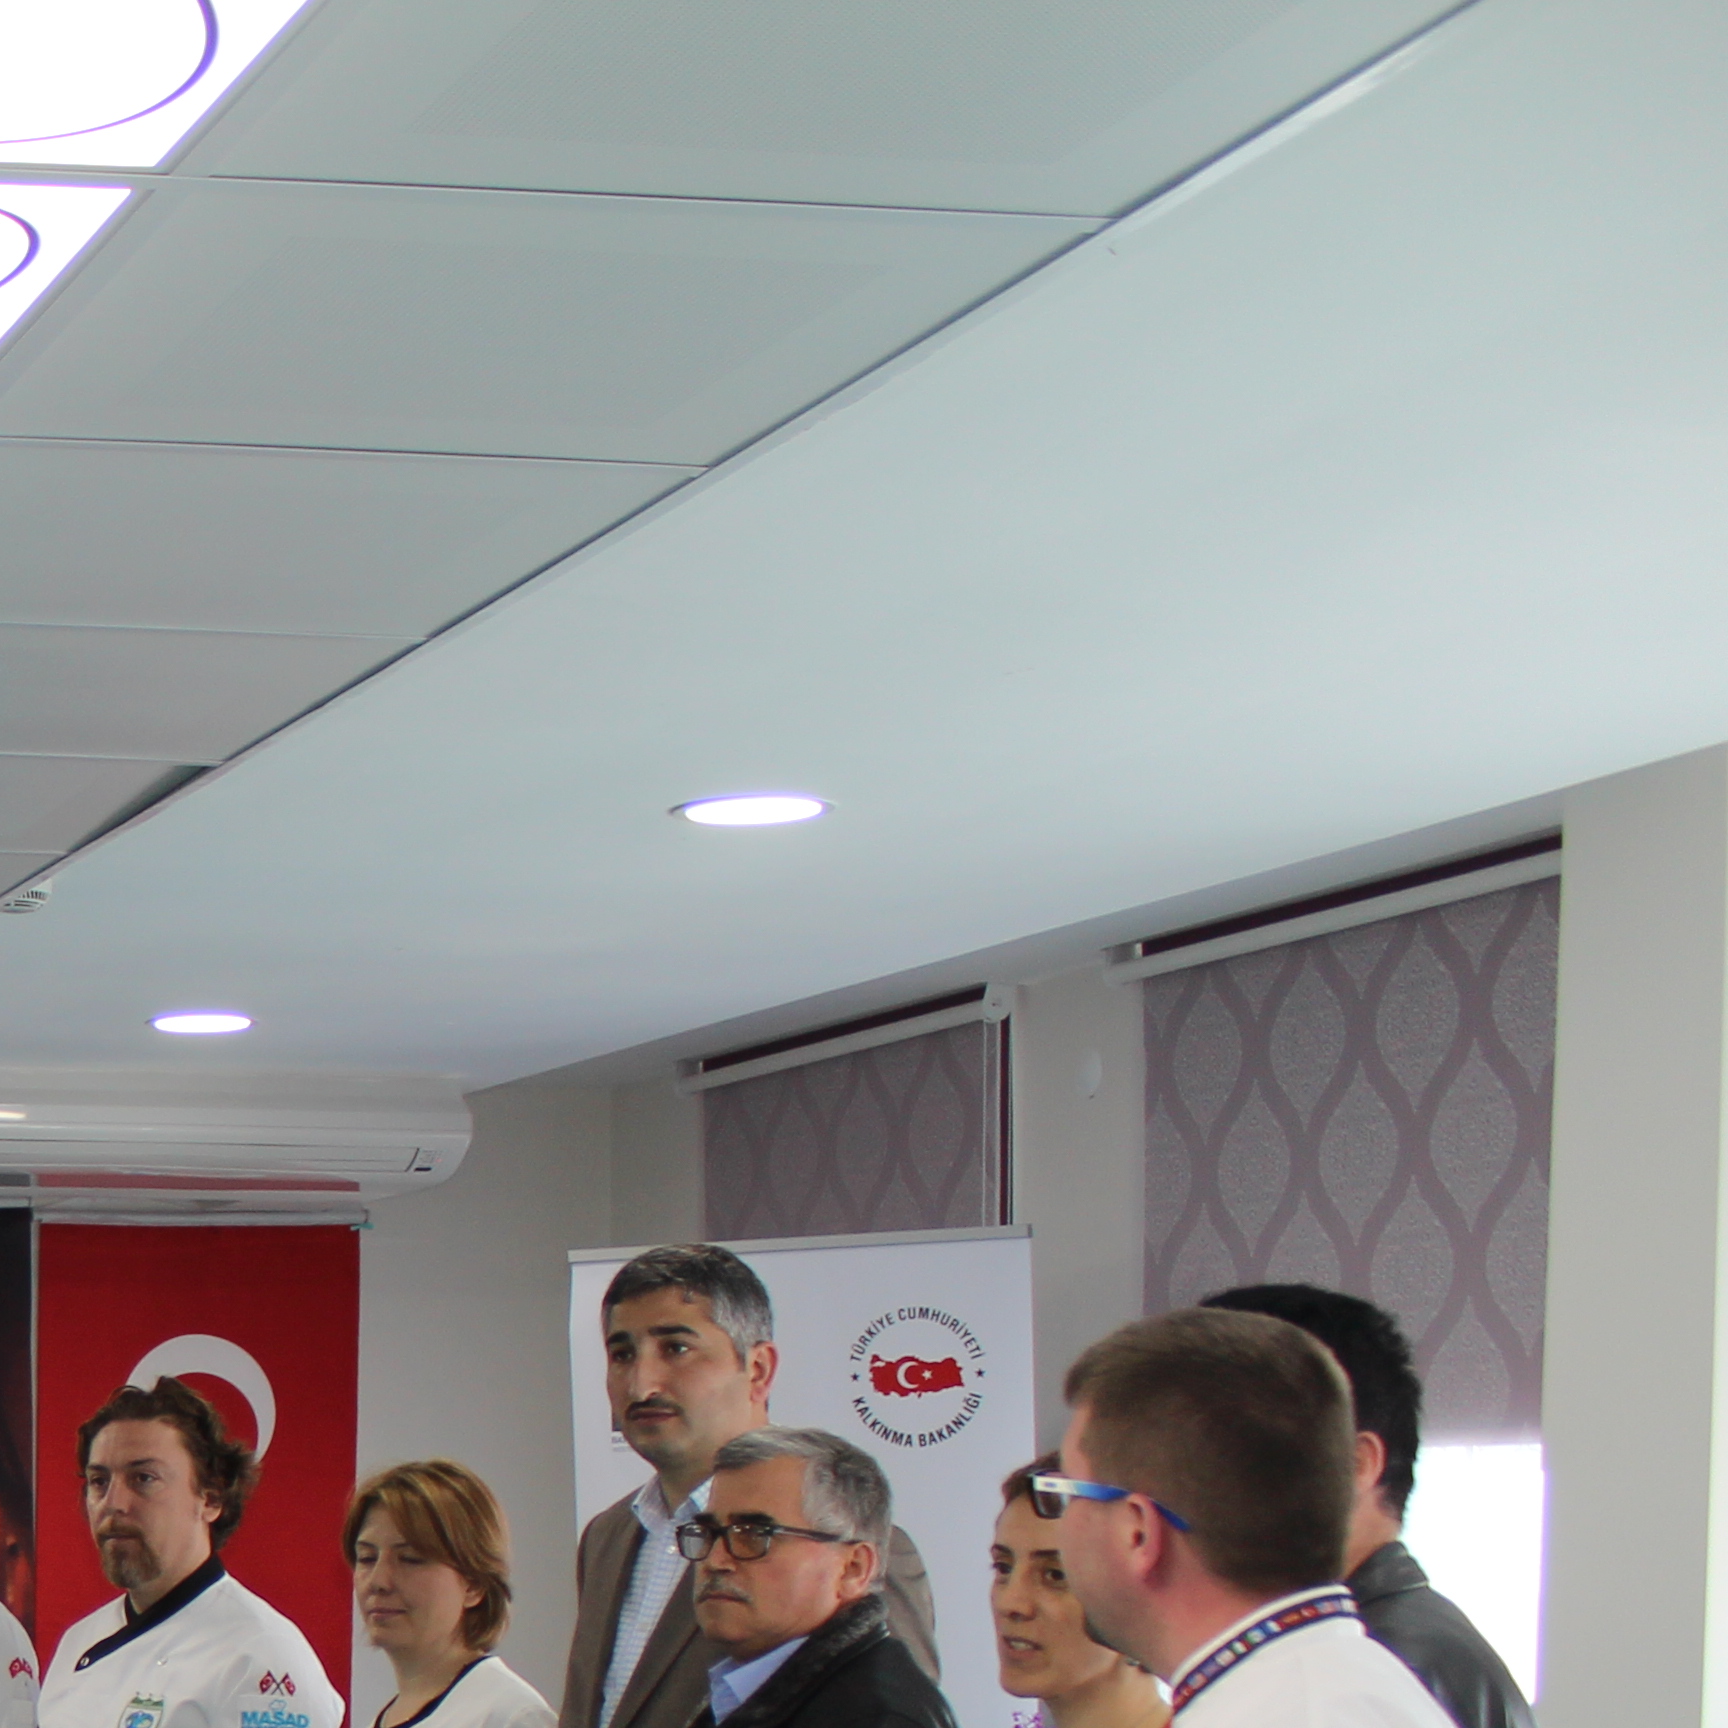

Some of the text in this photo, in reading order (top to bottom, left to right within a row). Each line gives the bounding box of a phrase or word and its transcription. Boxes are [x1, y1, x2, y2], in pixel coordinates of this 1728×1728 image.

[850, 1307, 986, 1362] TÜRKİYE CUMHURİYETİ
[852, 1392, 983, 1448] KALKINMA BAKANLIĞI
[241, 1711, 310, 1728] MASAD
